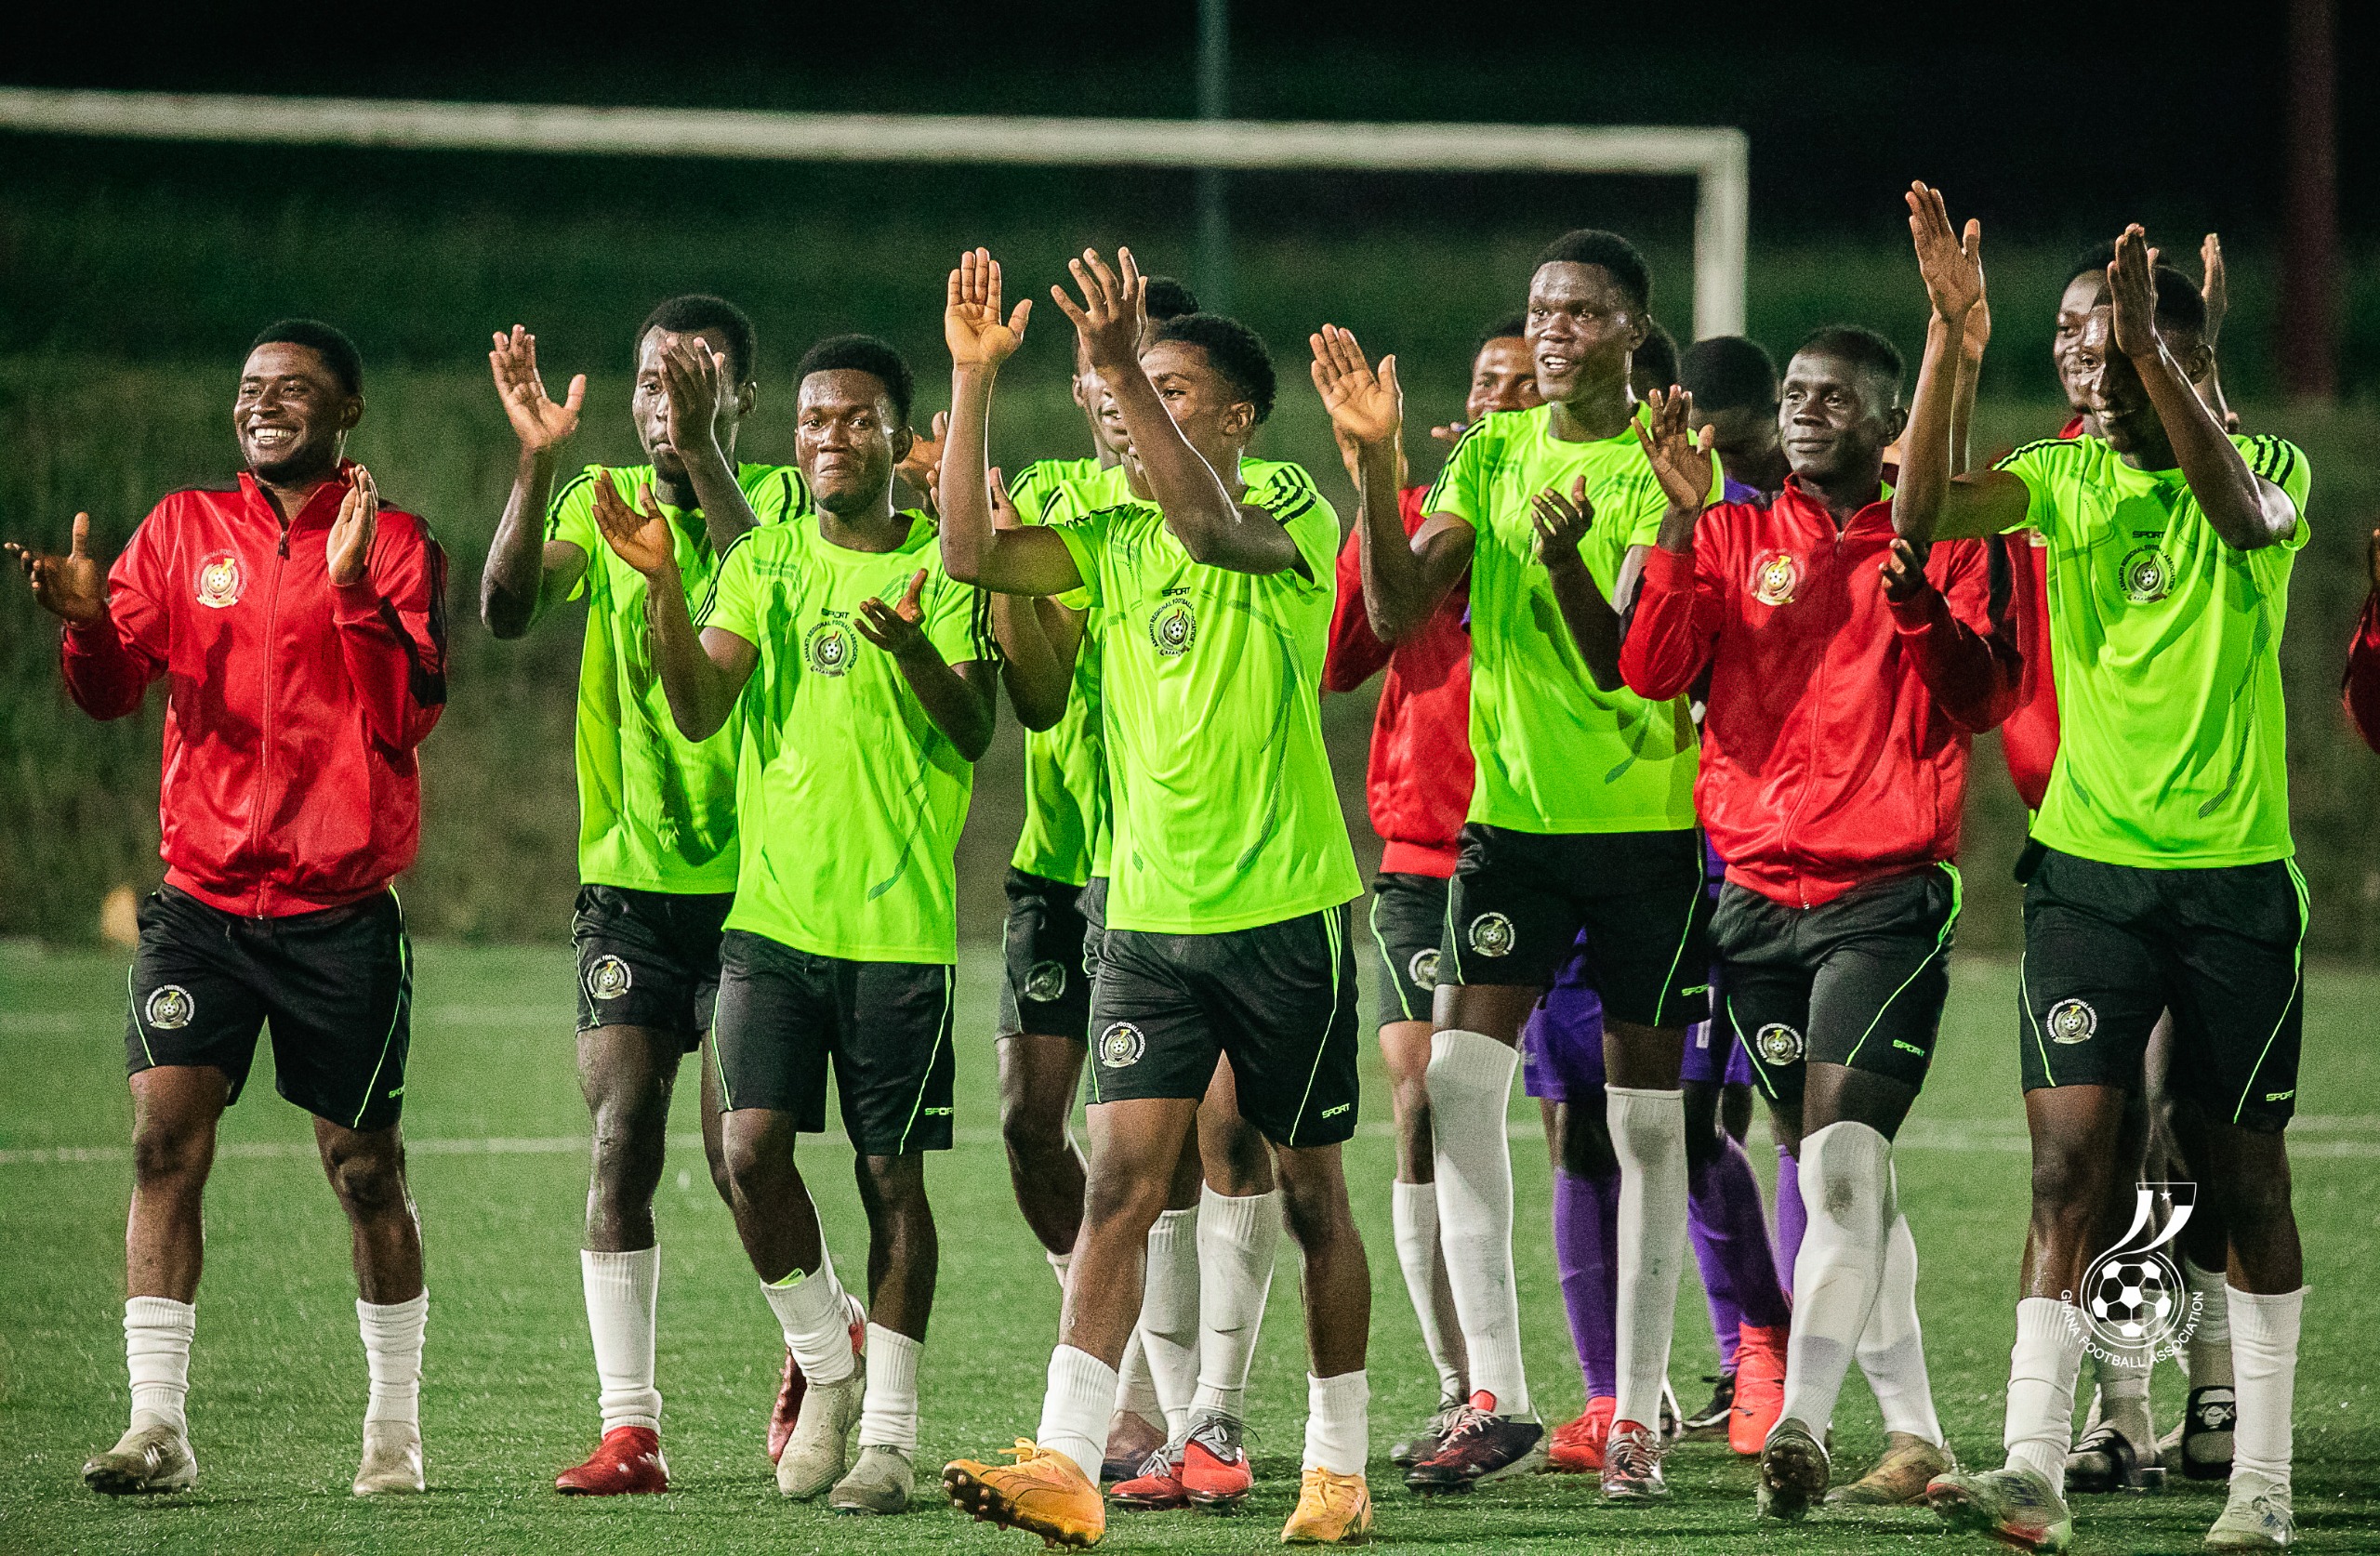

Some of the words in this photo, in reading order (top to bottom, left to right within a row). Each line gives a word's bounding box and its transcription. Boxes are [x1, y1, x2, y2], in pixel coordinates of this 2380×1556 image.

[1161, 587, 1191, 597] SPORT
[821, 608, 850, 618] SPORT
[1150, 601, 1172, 623] REGIONAL
[1172, 598, 1193, 610] FOOTBALL
[807, 620, 831, 639] REGIONAL
[832, 619, 852, 634] FOOTBALL
[847, 633, 858, 669] ASSOCIATION
[1681, 983, 1710, 996] SPOR
[1117, 1021, 1140, 1032] FOOTBALL
[1893, 1039, 1925, 1057] SPORT
[925, 1107, 953, 1115] SPOR
[1321, 1102, 1351, 1119] SPORT
